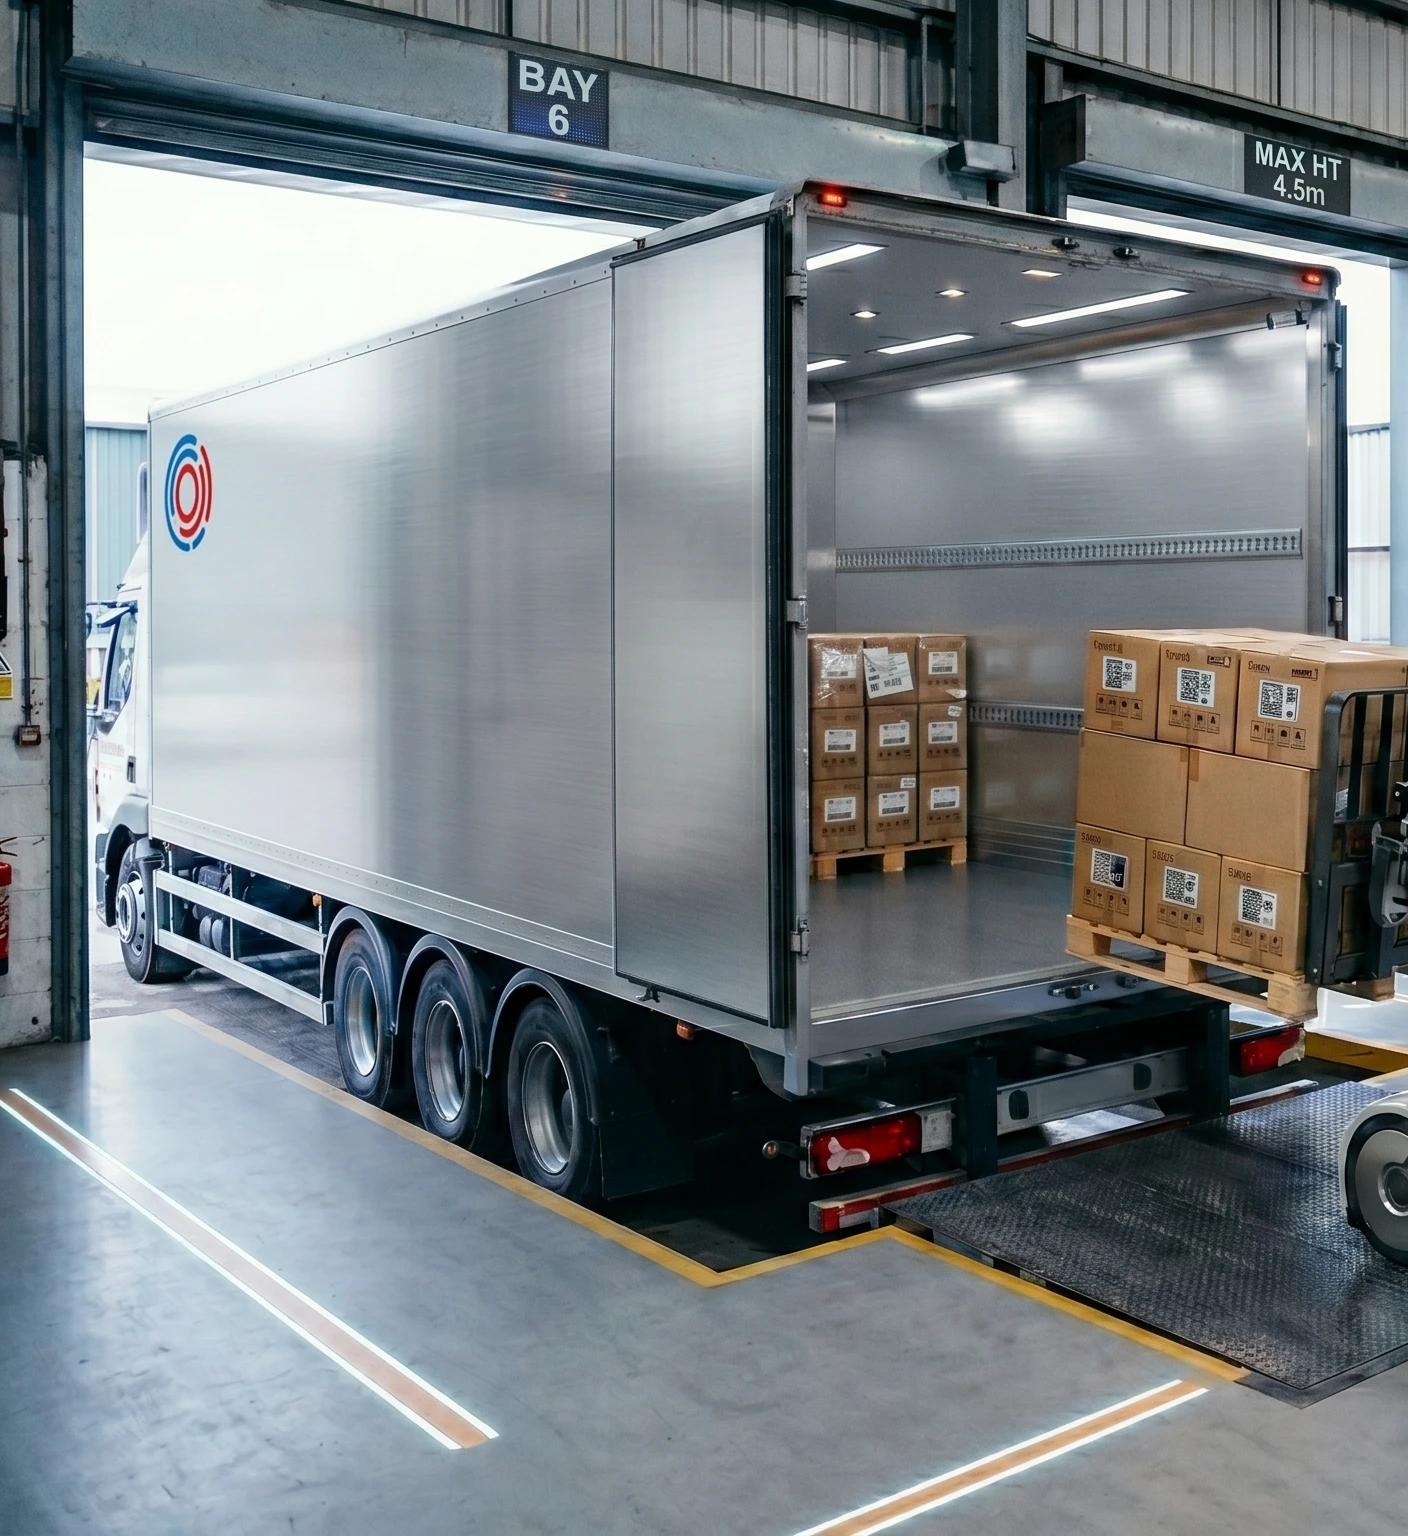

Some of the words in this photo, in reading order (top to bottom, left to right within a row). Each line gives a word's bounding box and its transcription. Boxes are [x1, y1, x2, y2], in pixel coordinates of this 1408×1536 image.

[519, 58, 599, 103] BAY
[548, 103, 570, 136] 6
[1255, 140, 1306, 174] MAX
[1312, 153, 1342, 181] HT
[1273, 173, 1325, 206] 4.5m
